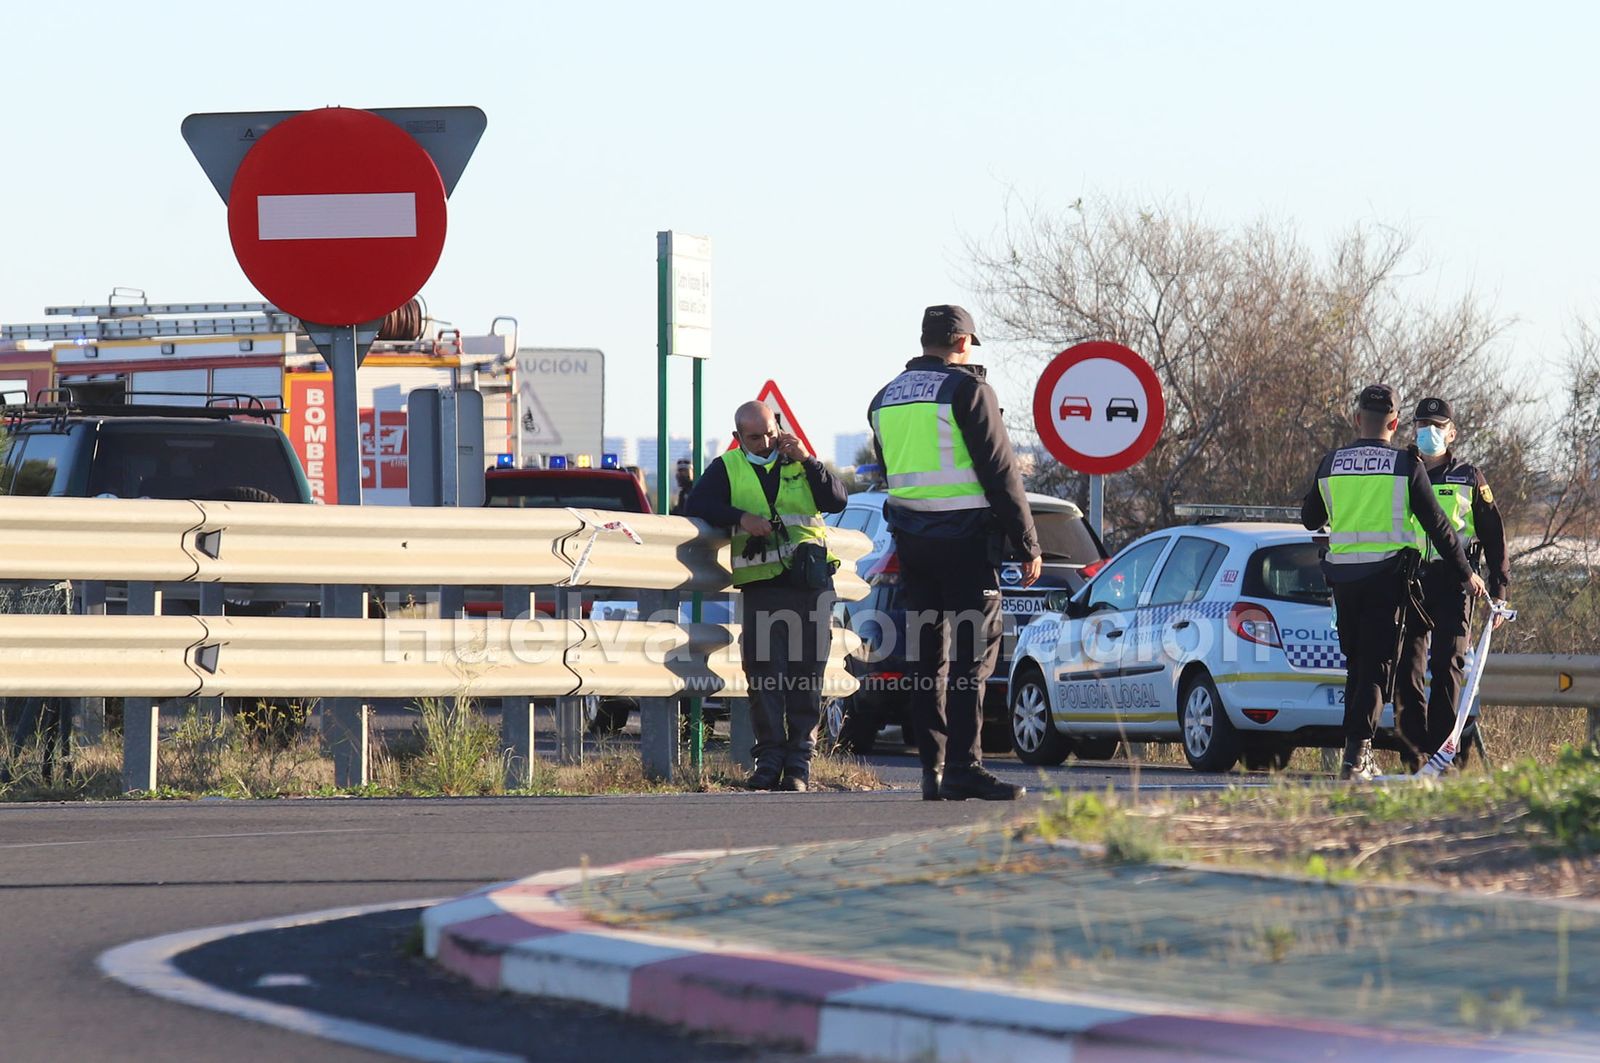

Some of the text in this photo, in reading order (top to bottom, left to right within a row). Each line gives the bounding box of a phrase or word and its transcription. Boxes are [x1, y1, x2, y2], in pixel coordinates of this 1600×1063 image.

[886, 384, 935, 401] POLICIA
[1333, 458, 1391, 471] POLICIA
[1112, 683, 1160, 708] LOCAL
